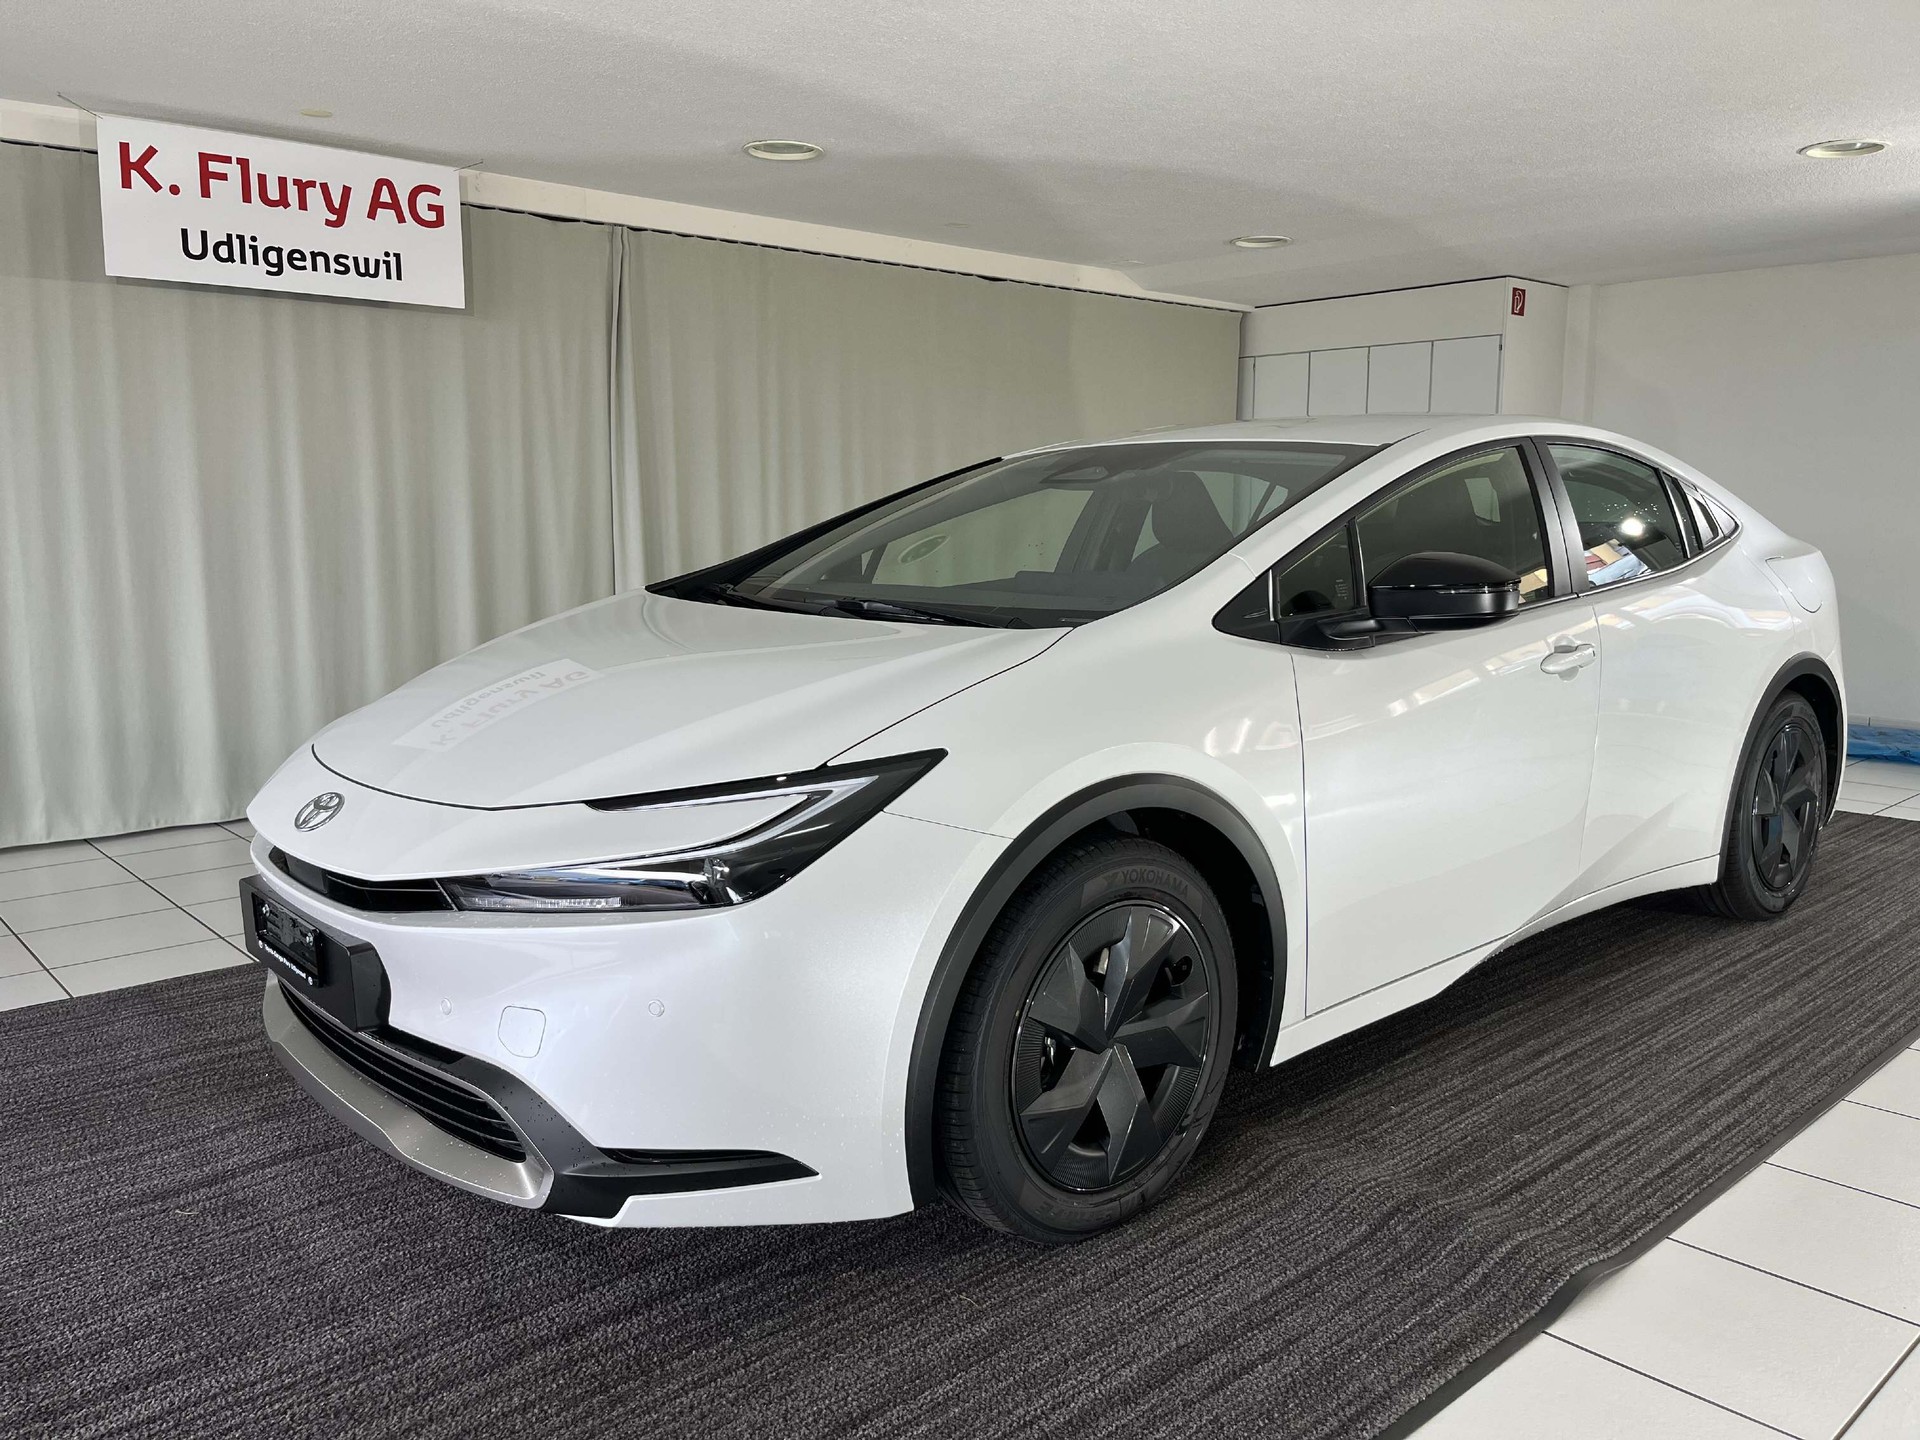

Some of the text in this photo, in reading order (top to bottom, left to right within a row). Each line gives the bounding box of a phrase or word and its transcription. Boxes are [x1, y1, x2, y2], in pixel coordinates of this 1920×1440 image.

[118, 141, 445, 228] K. Flury AG
[180, 228, 403, 281] Udligenswil
[1121, 868, 1189, 898] YOKOHAMA
